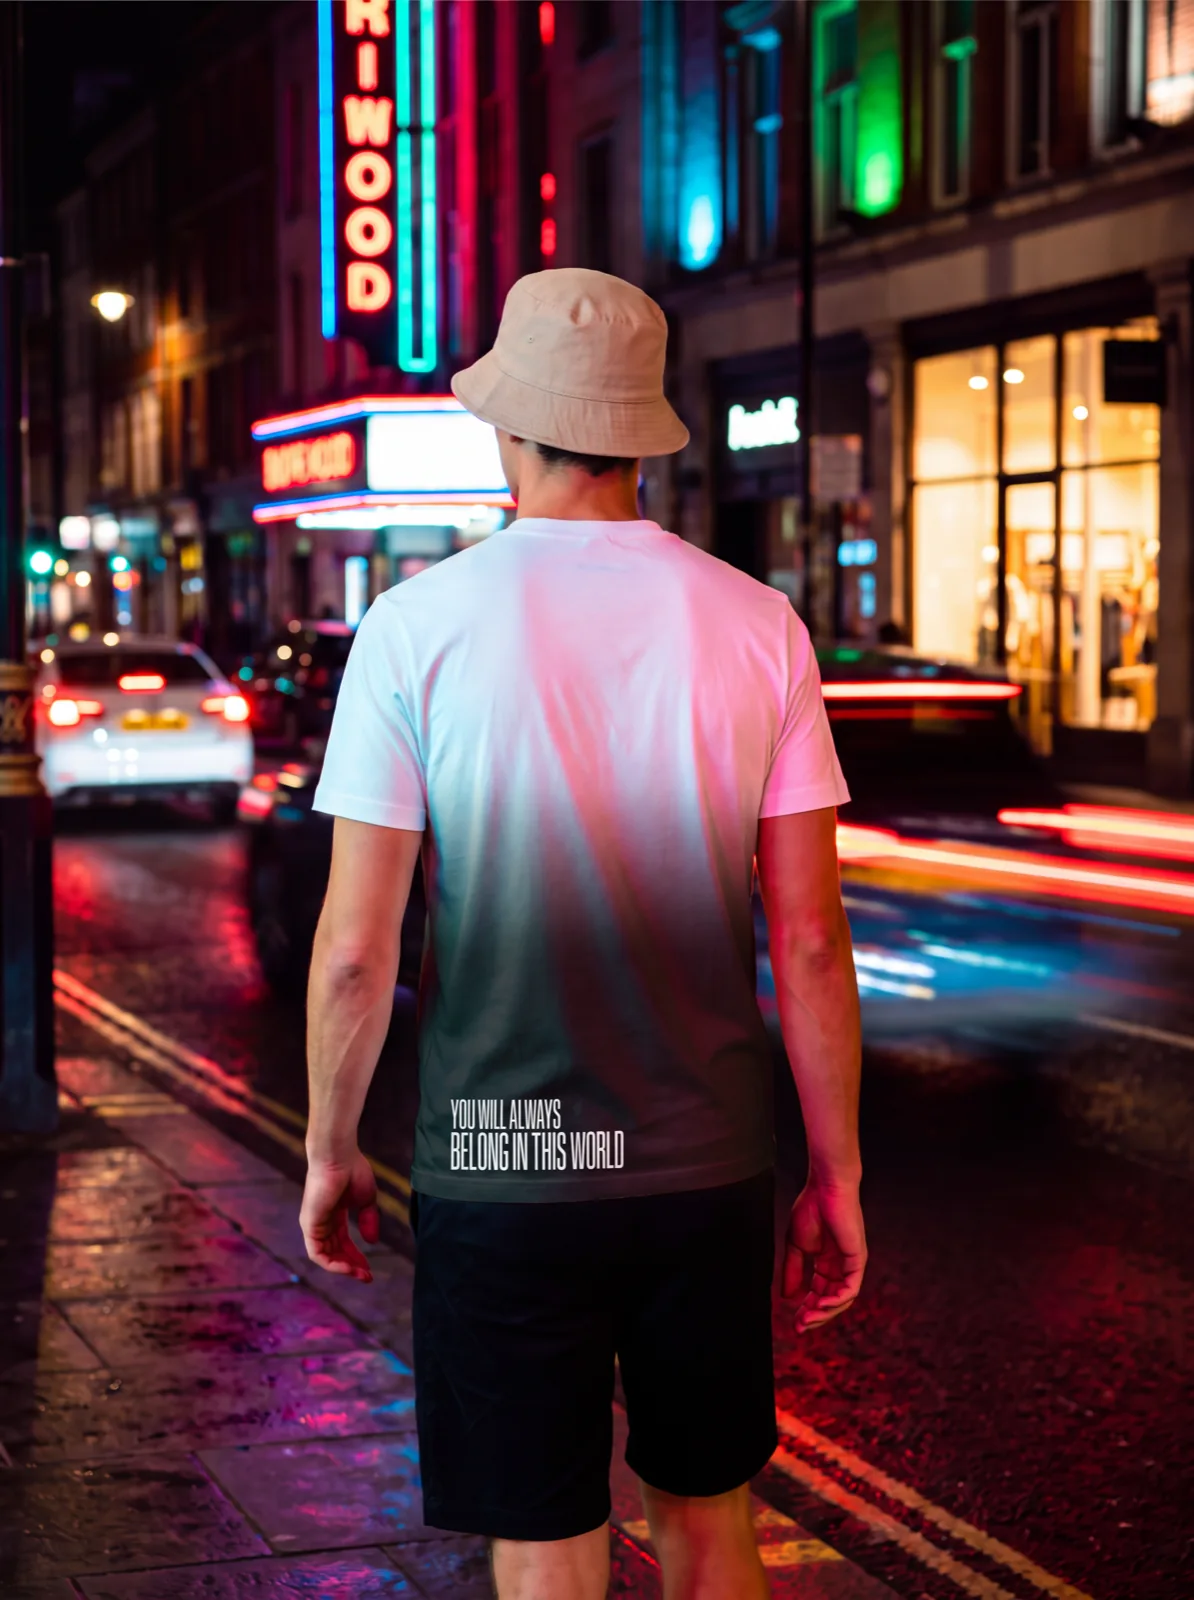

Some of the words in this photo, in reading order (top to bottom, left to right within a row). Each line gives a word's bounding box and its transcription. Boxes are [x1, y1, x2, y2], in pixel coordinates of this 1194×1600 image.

[450, 1099, 475, 1129] YOU
[477, 1099, 507, 1129] WILL
[509, 1099, 561, 1129] ALWAYS
[450, 1132, 509, 1170] BELONG
[512, 1132, 529, 1170] IN
[531, 1131, 567, 1170] THIS
[570, 1131, 625, 1169] WORLD
